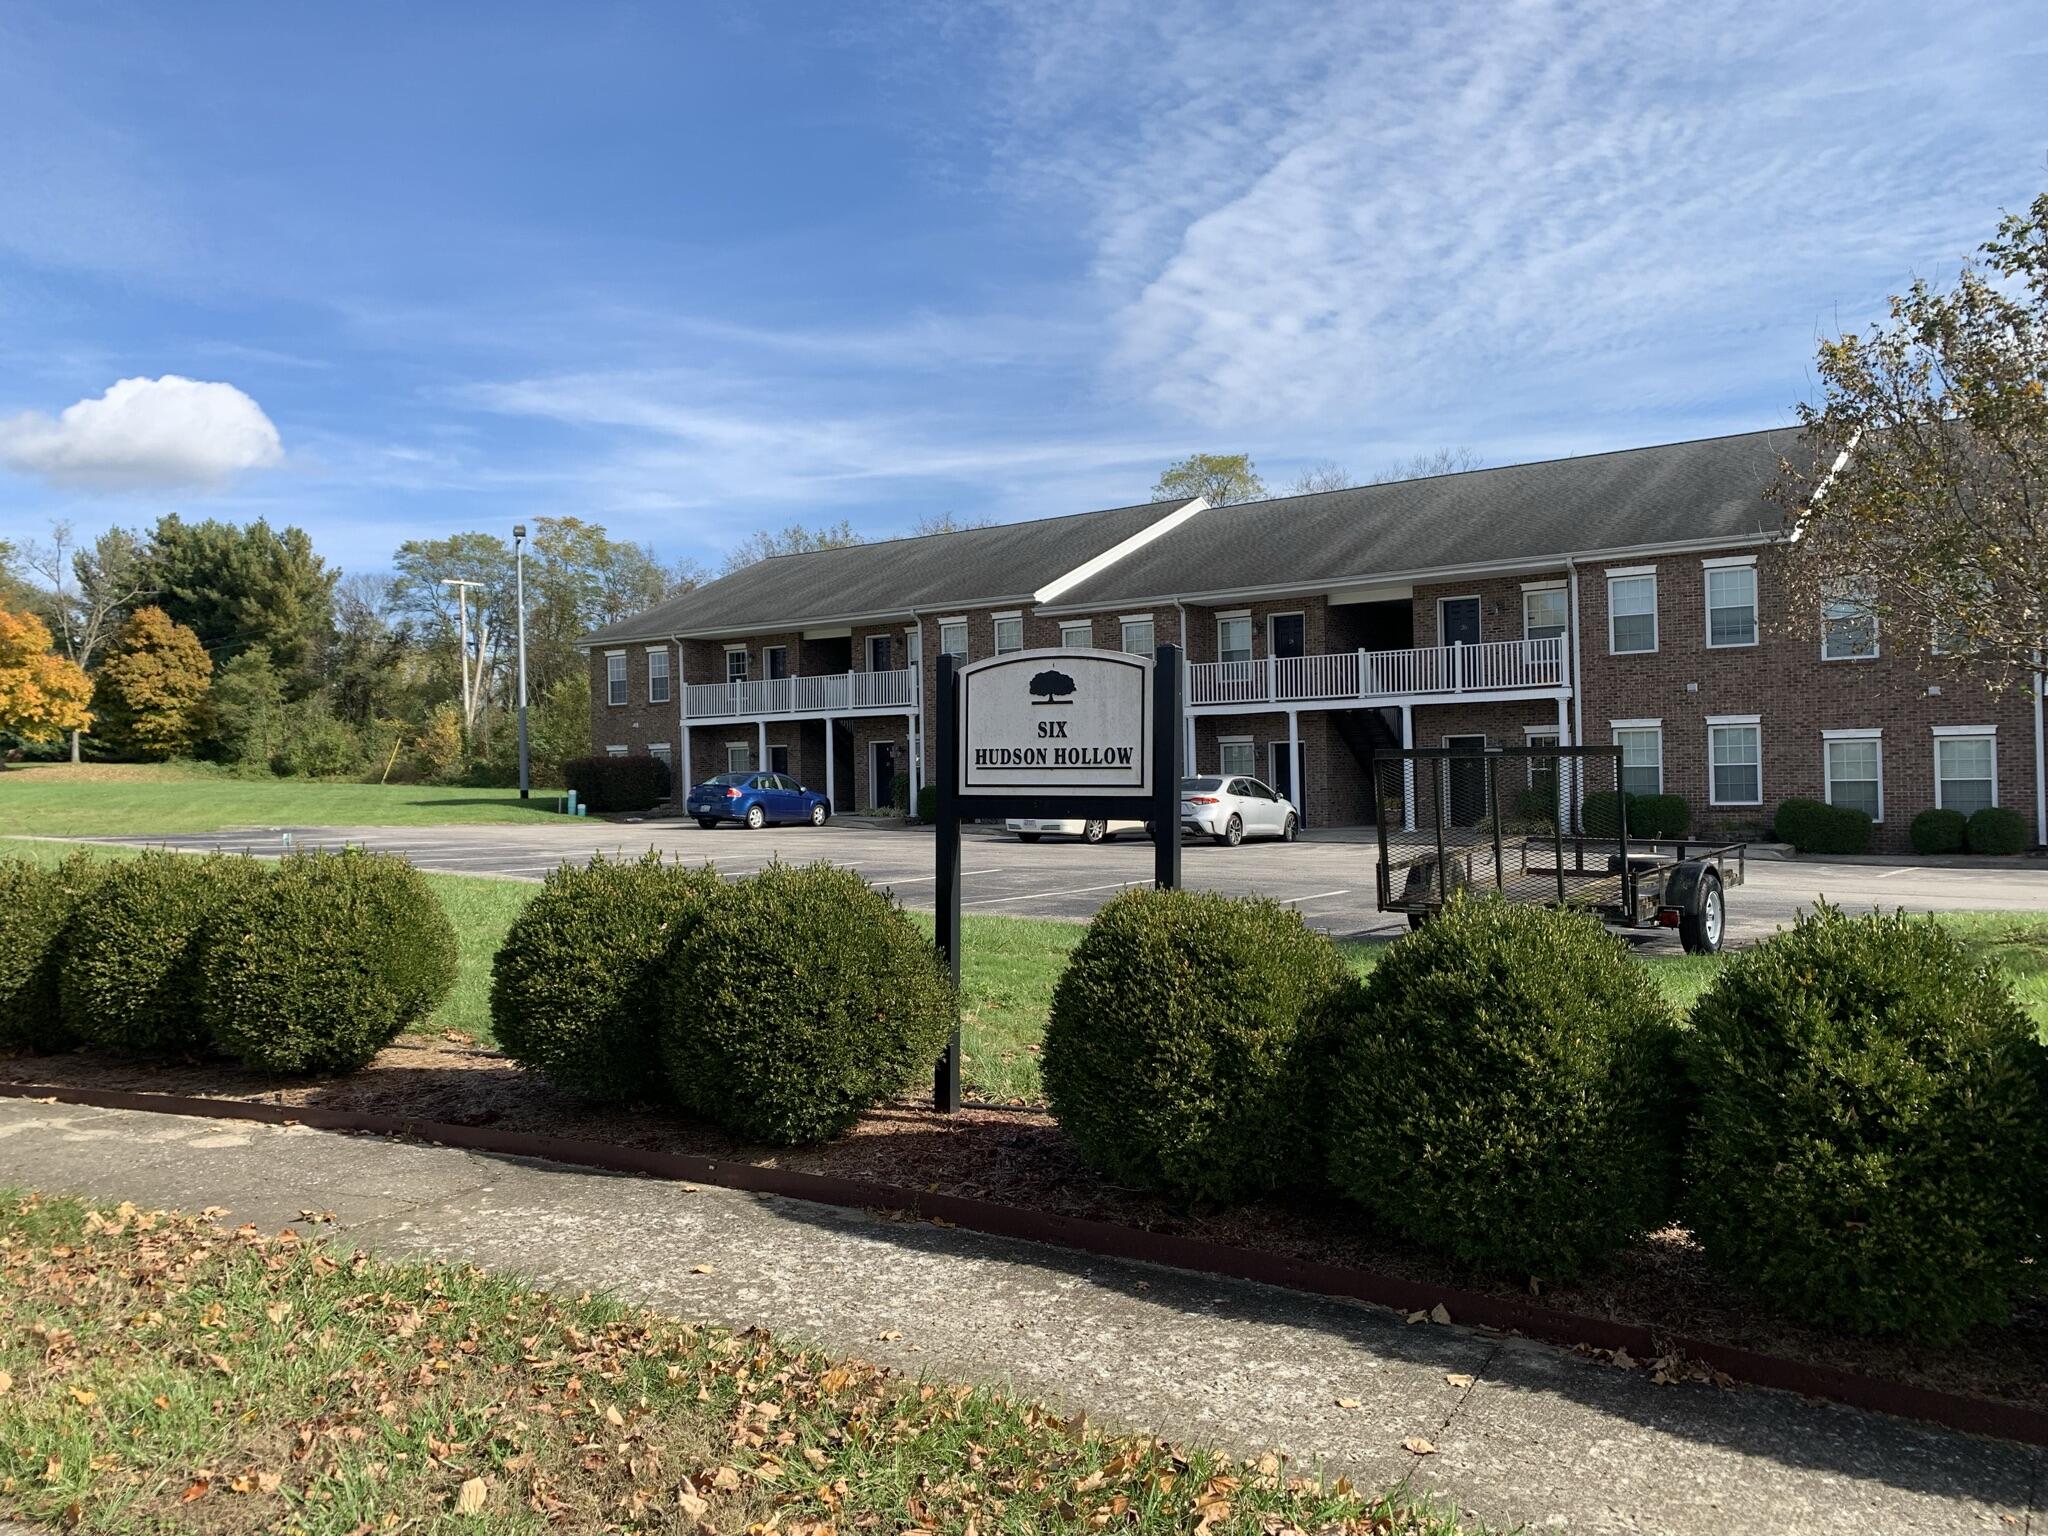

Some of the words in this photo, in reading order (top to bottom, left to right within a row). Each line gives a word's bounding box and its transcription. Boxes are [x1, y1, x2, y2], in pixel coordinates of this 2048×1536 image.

[1037, 720, 1068, 738] SIX
[975, 748, 1047, 765] HUDSON
[1053, 747, 1133, 765] HOLLOW
